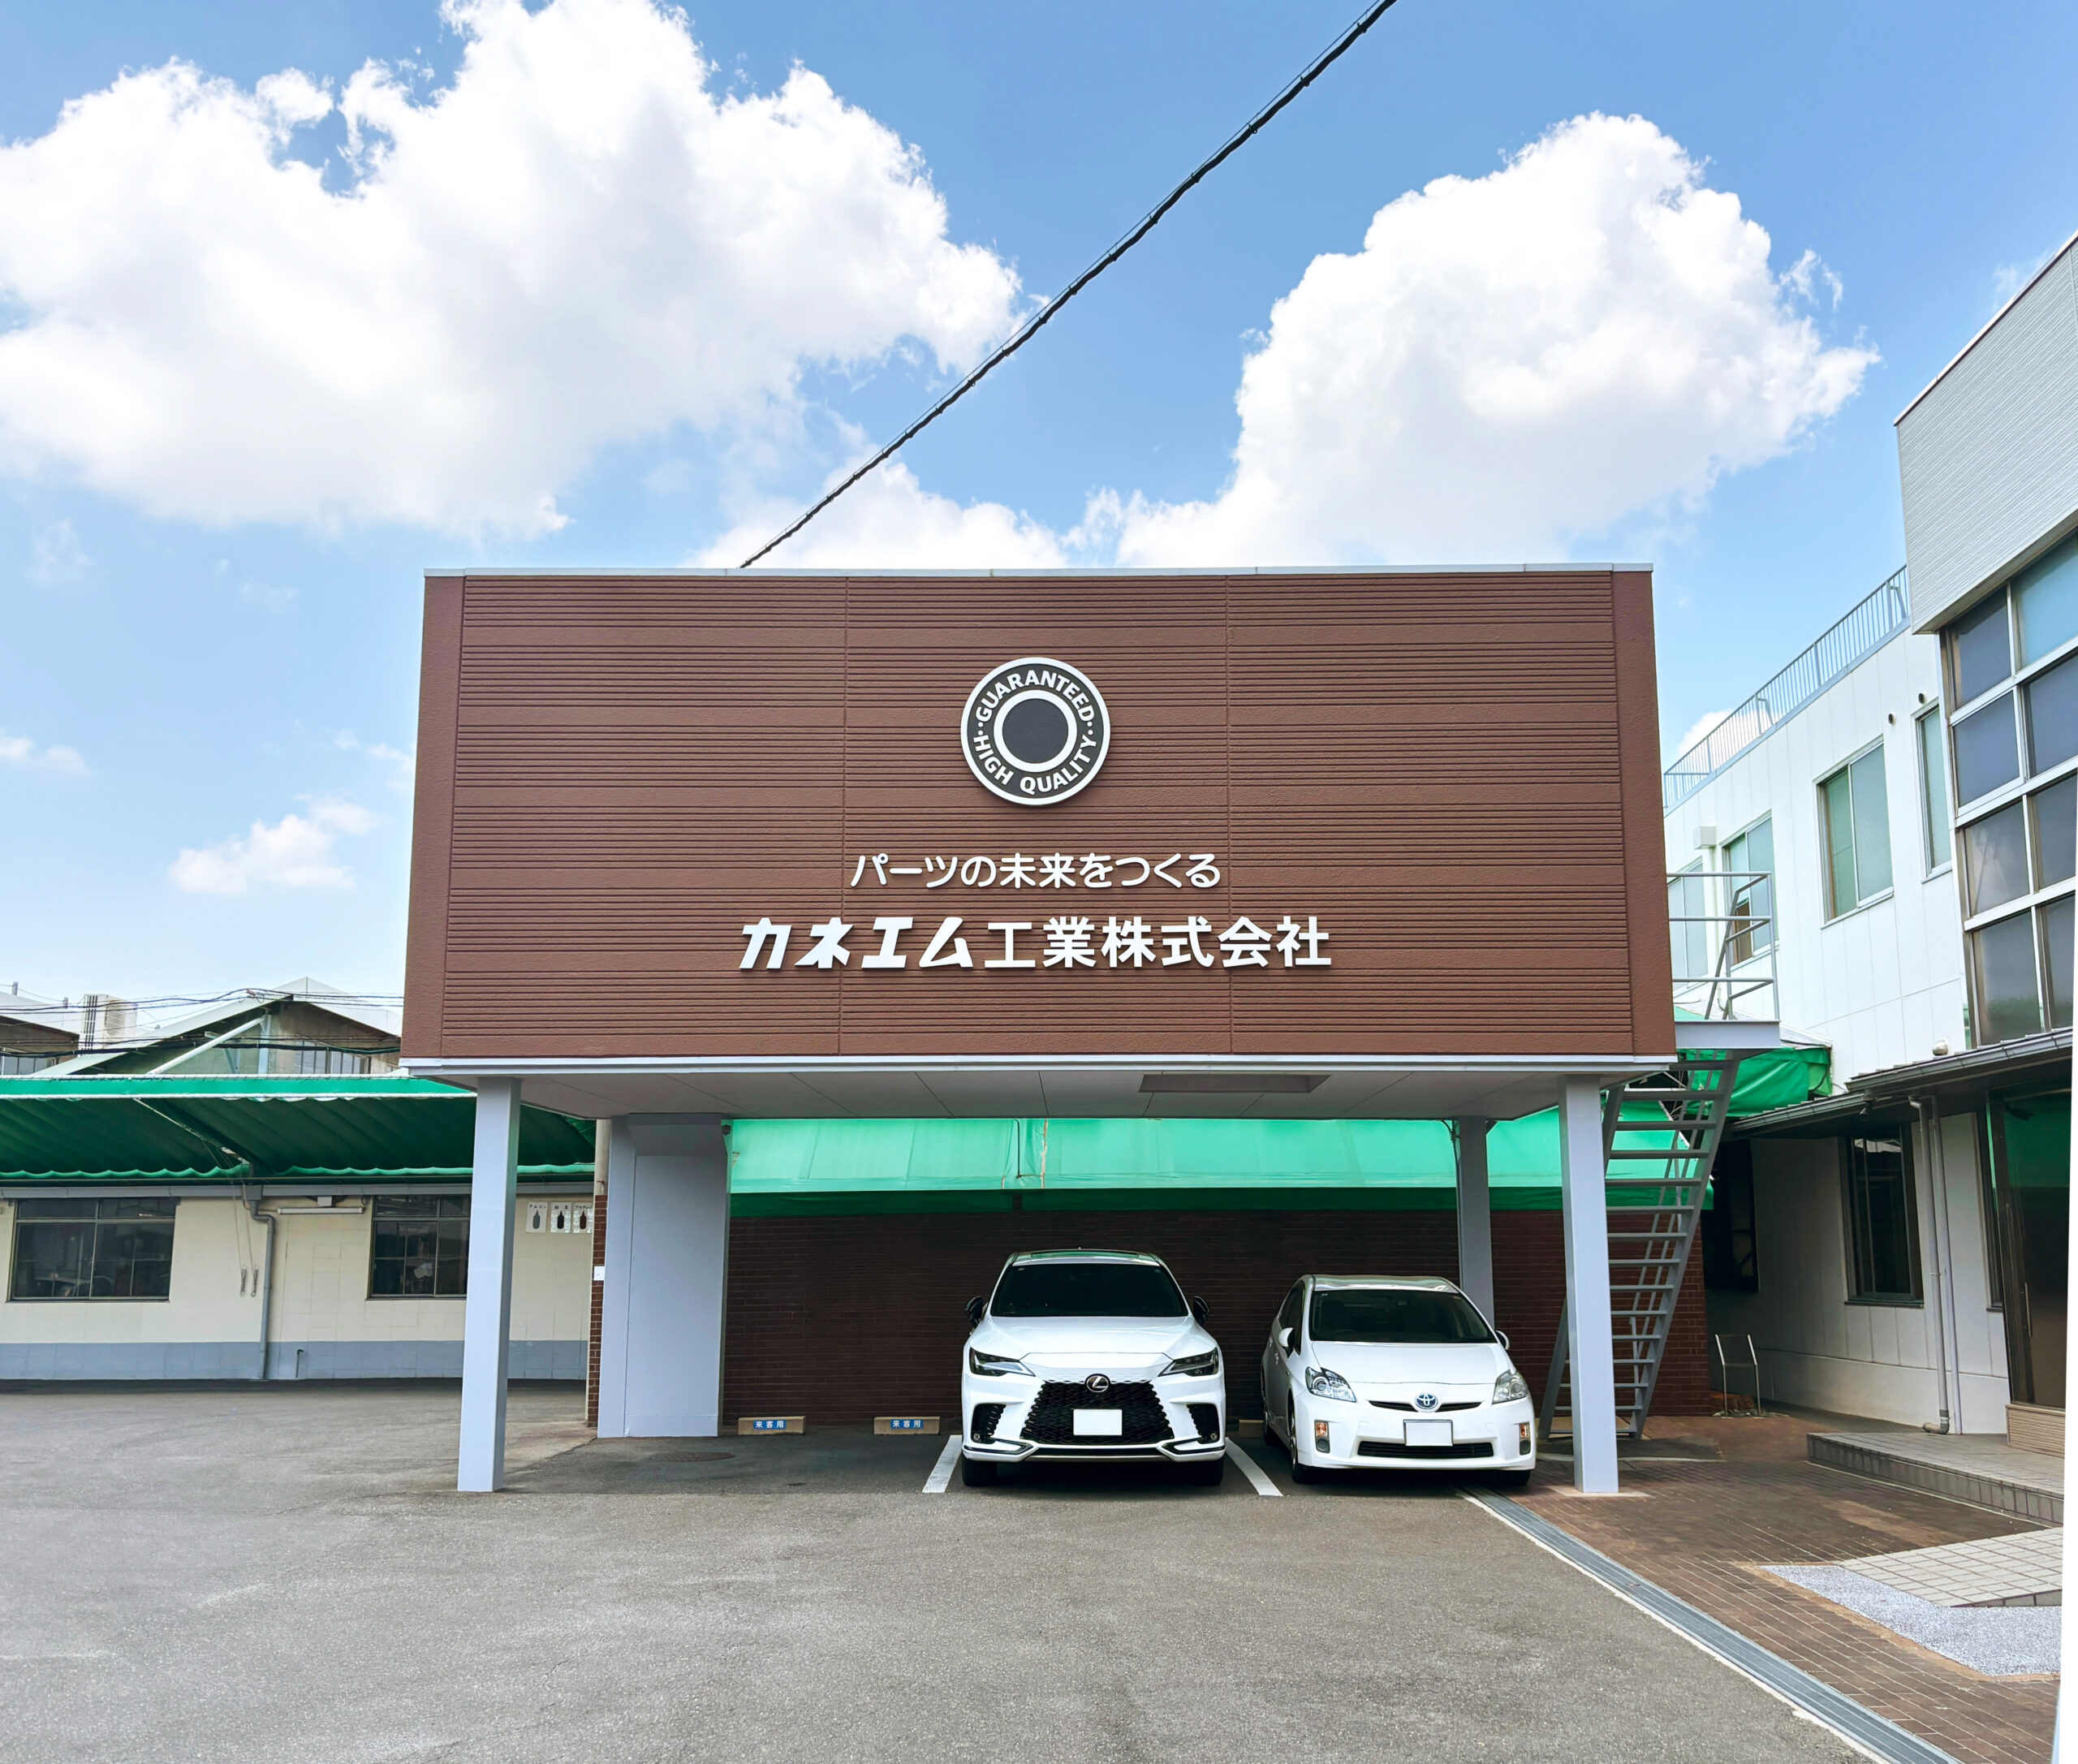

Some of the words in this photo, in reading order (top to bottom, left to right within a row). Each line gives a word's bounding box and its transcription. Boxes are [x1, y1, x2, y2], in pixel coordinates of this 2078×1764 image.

[976, 670, 1095, 722] GUARANTEED
[973, 735, 1014, 786] HIGH
[1020, 735, 1097, 796] QUALITY
[851, 852, 1221, 888] パーツの未来をつくる
[739, 915, 1332, 969] カネエム工業株式会社
[755, 1420, 784, 1429] 来客用
[892, 1420, 921, 1428] 来客用
